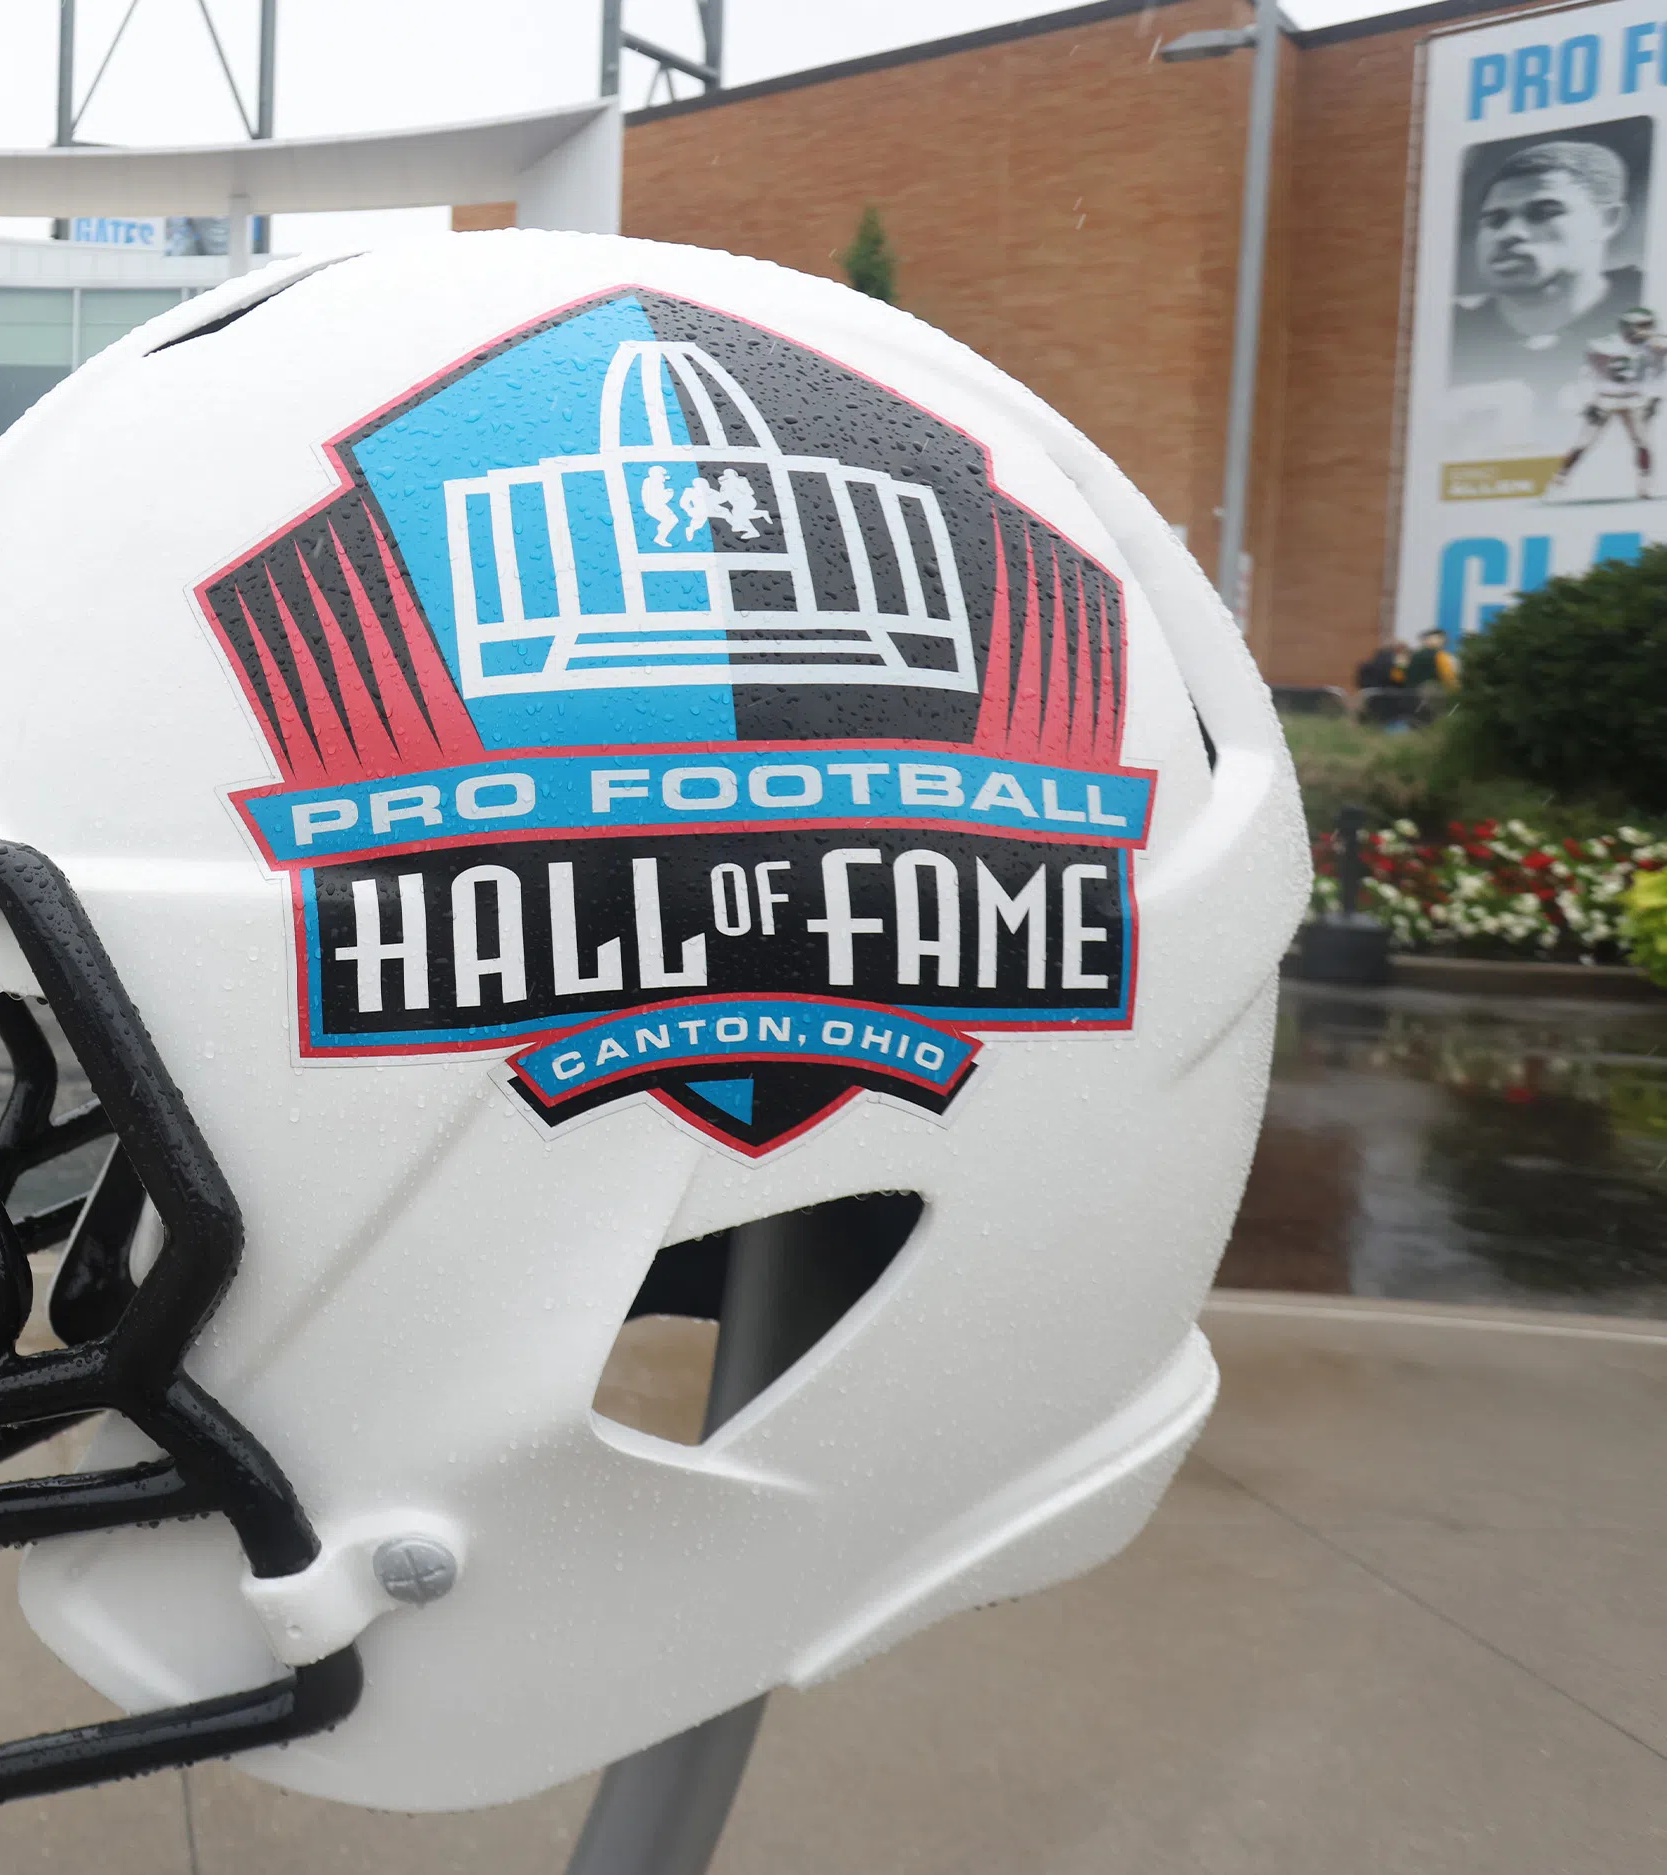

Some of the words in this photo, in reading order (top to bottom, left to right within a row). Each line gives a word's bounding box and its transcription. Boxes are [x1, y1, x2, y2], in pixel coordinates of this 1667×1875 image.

[1467, 34, 1600, 121] PRO
[1620, 21, 1667, 95] F
[290, 772, 534, 846] PRO
[589, 762, 1128, 828] FOOTBALL
[335, 857, 707, 1013] HALL
[710, 860, 791, 937] OF
[807, 848, 1112, 990] FAME
[550, 1014, 808, 1081] CANTON,
[820, 1020, 946, 1071] OHIO
